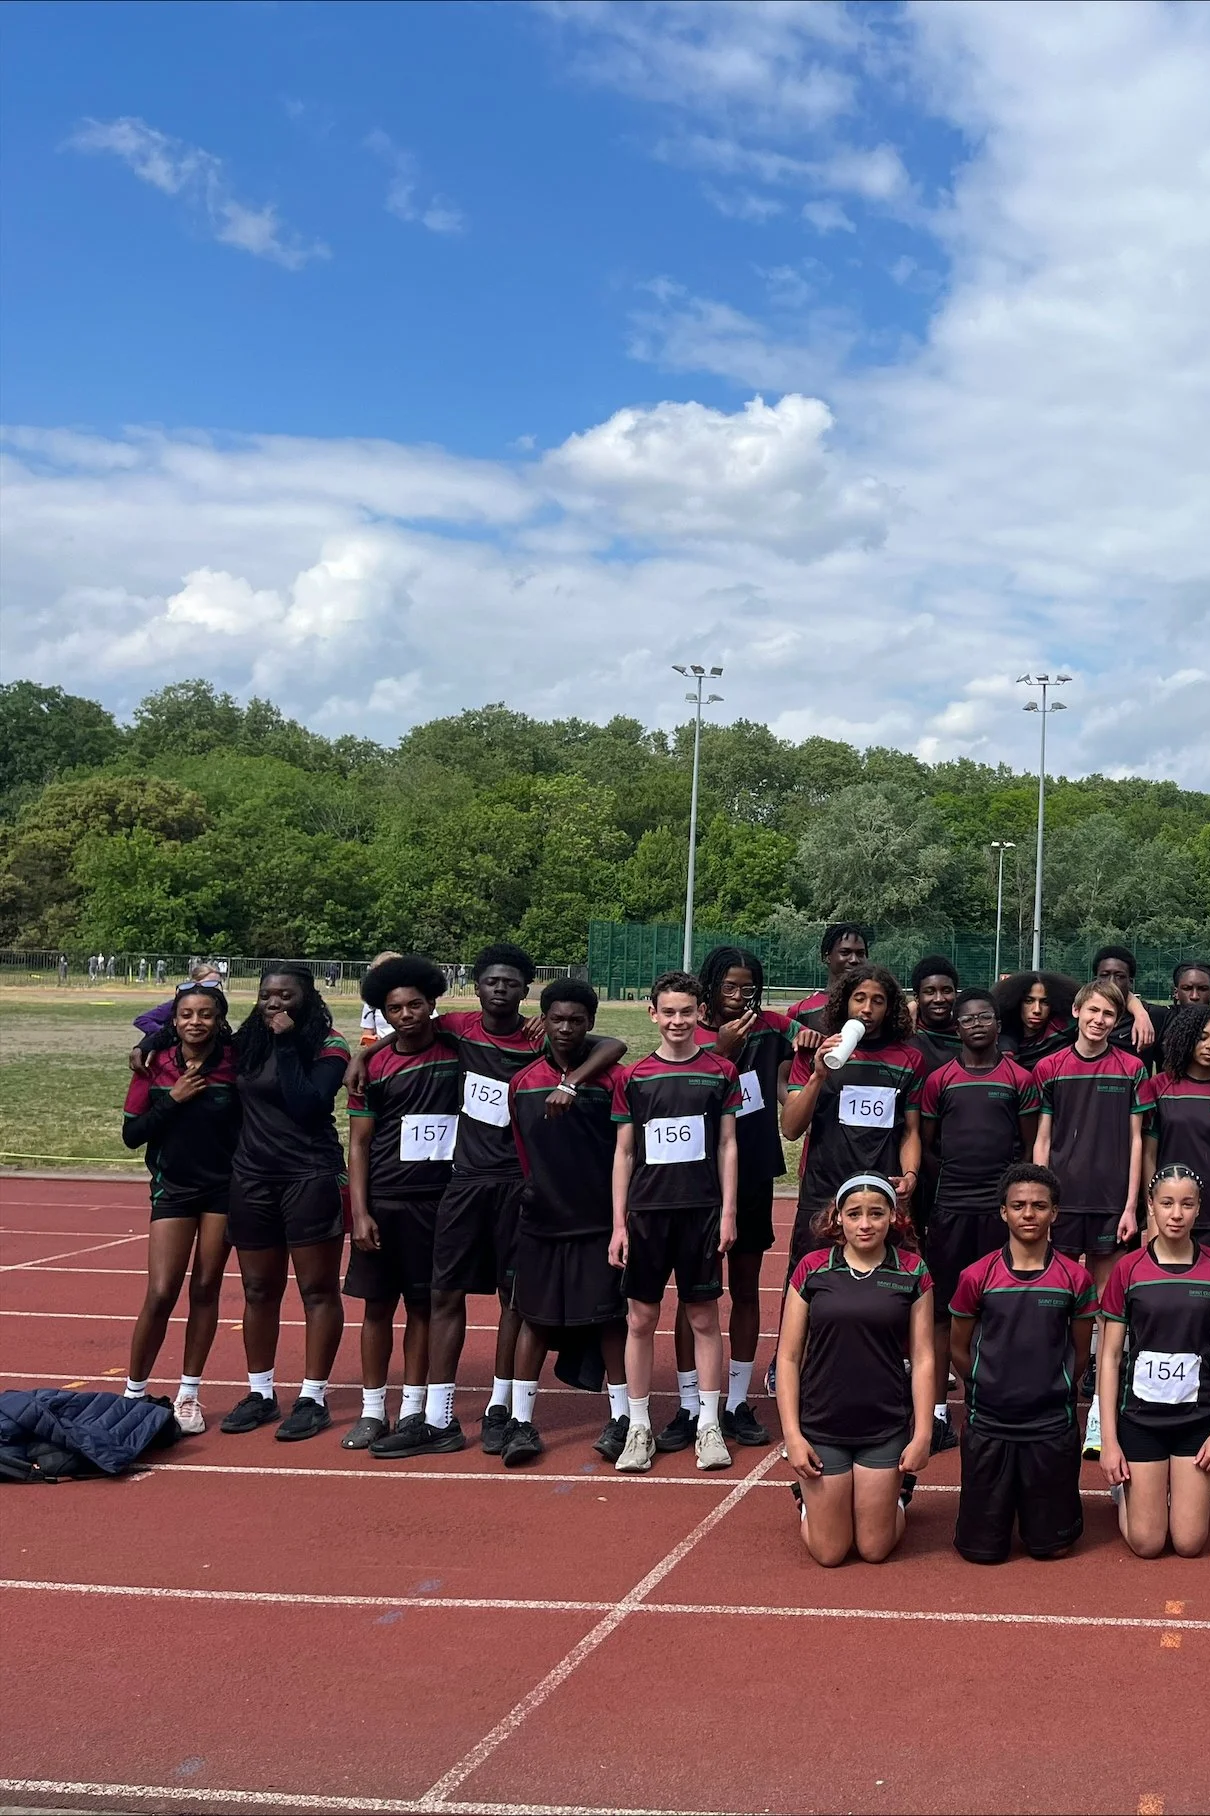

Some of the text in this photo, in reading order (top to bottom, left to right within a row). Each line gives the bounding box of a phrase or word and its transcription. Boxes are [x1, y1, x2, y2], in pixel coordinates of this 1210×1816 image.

[471, 1083, 503, 1106] 152
[848, 1099, 884, 1117] 156
[411, 1125, 448, 1141] 157
[654, 1126, 691, 1143] 156
[1145, 1360, 1186, 1381] 154
